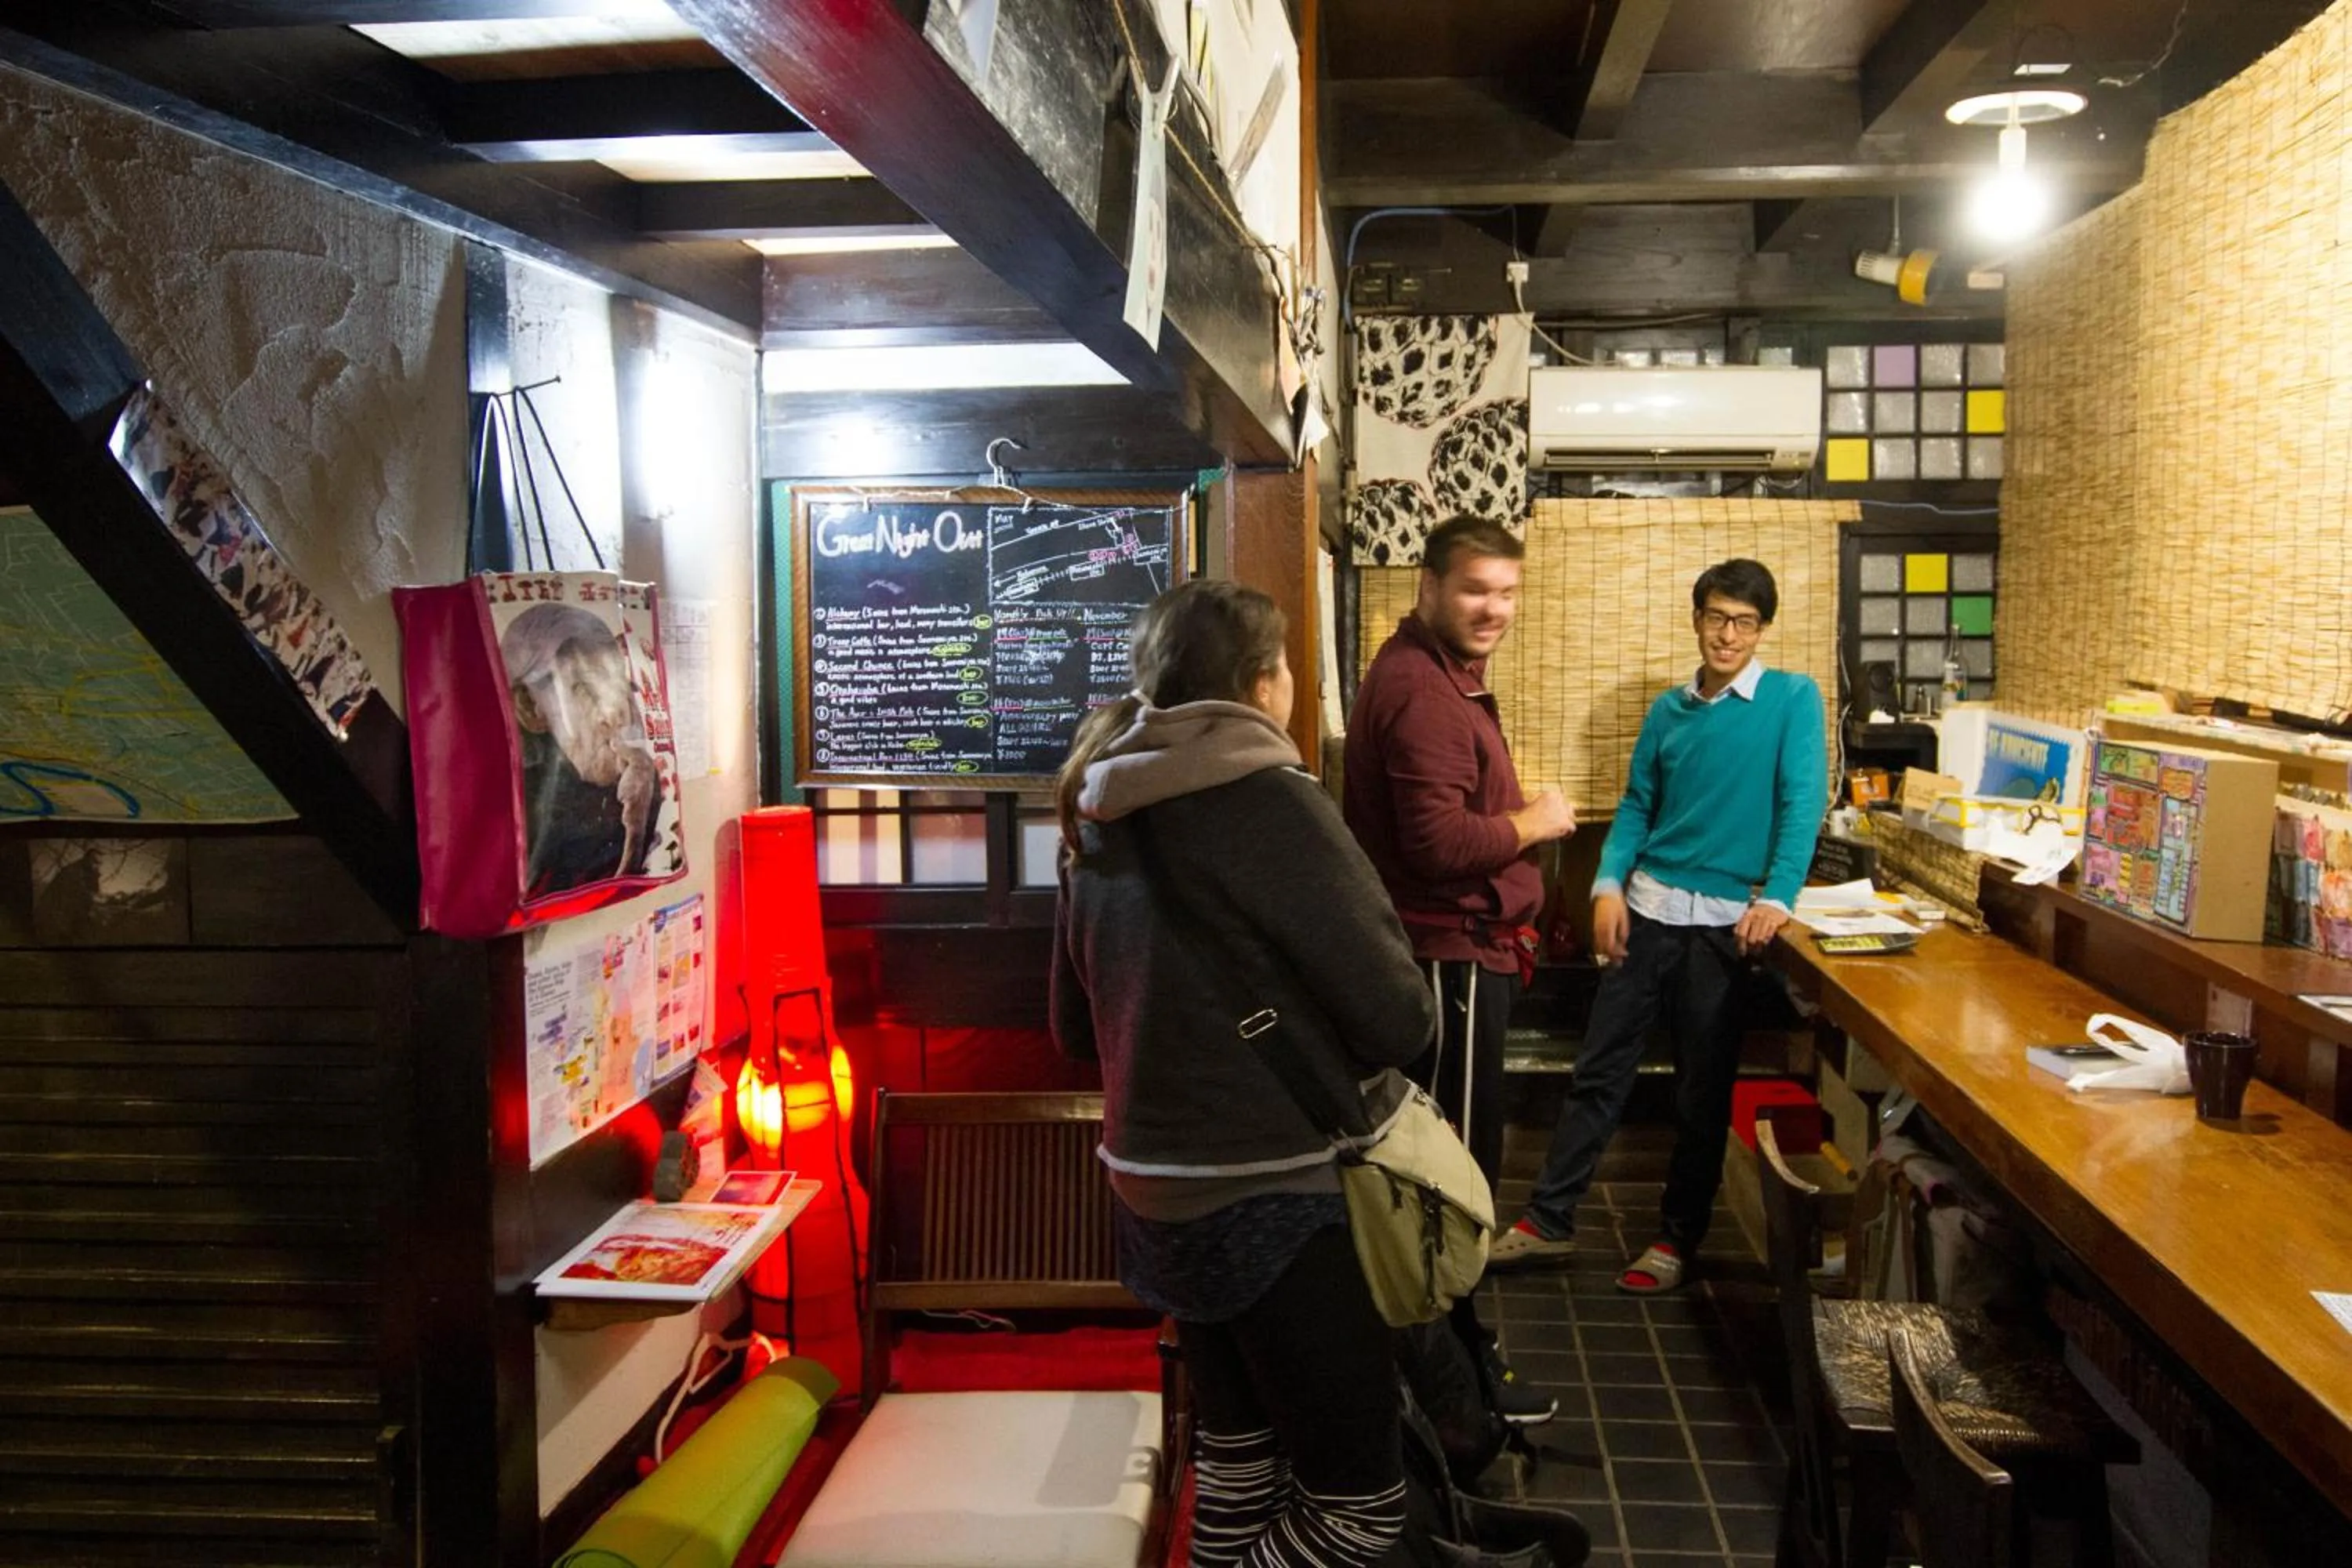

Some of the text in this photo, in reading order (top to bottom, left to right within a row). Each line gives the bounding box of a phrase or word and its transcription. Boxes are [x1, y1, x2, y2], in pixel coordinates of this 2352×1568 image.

[816, 510, 983, 558] Great Night Out
